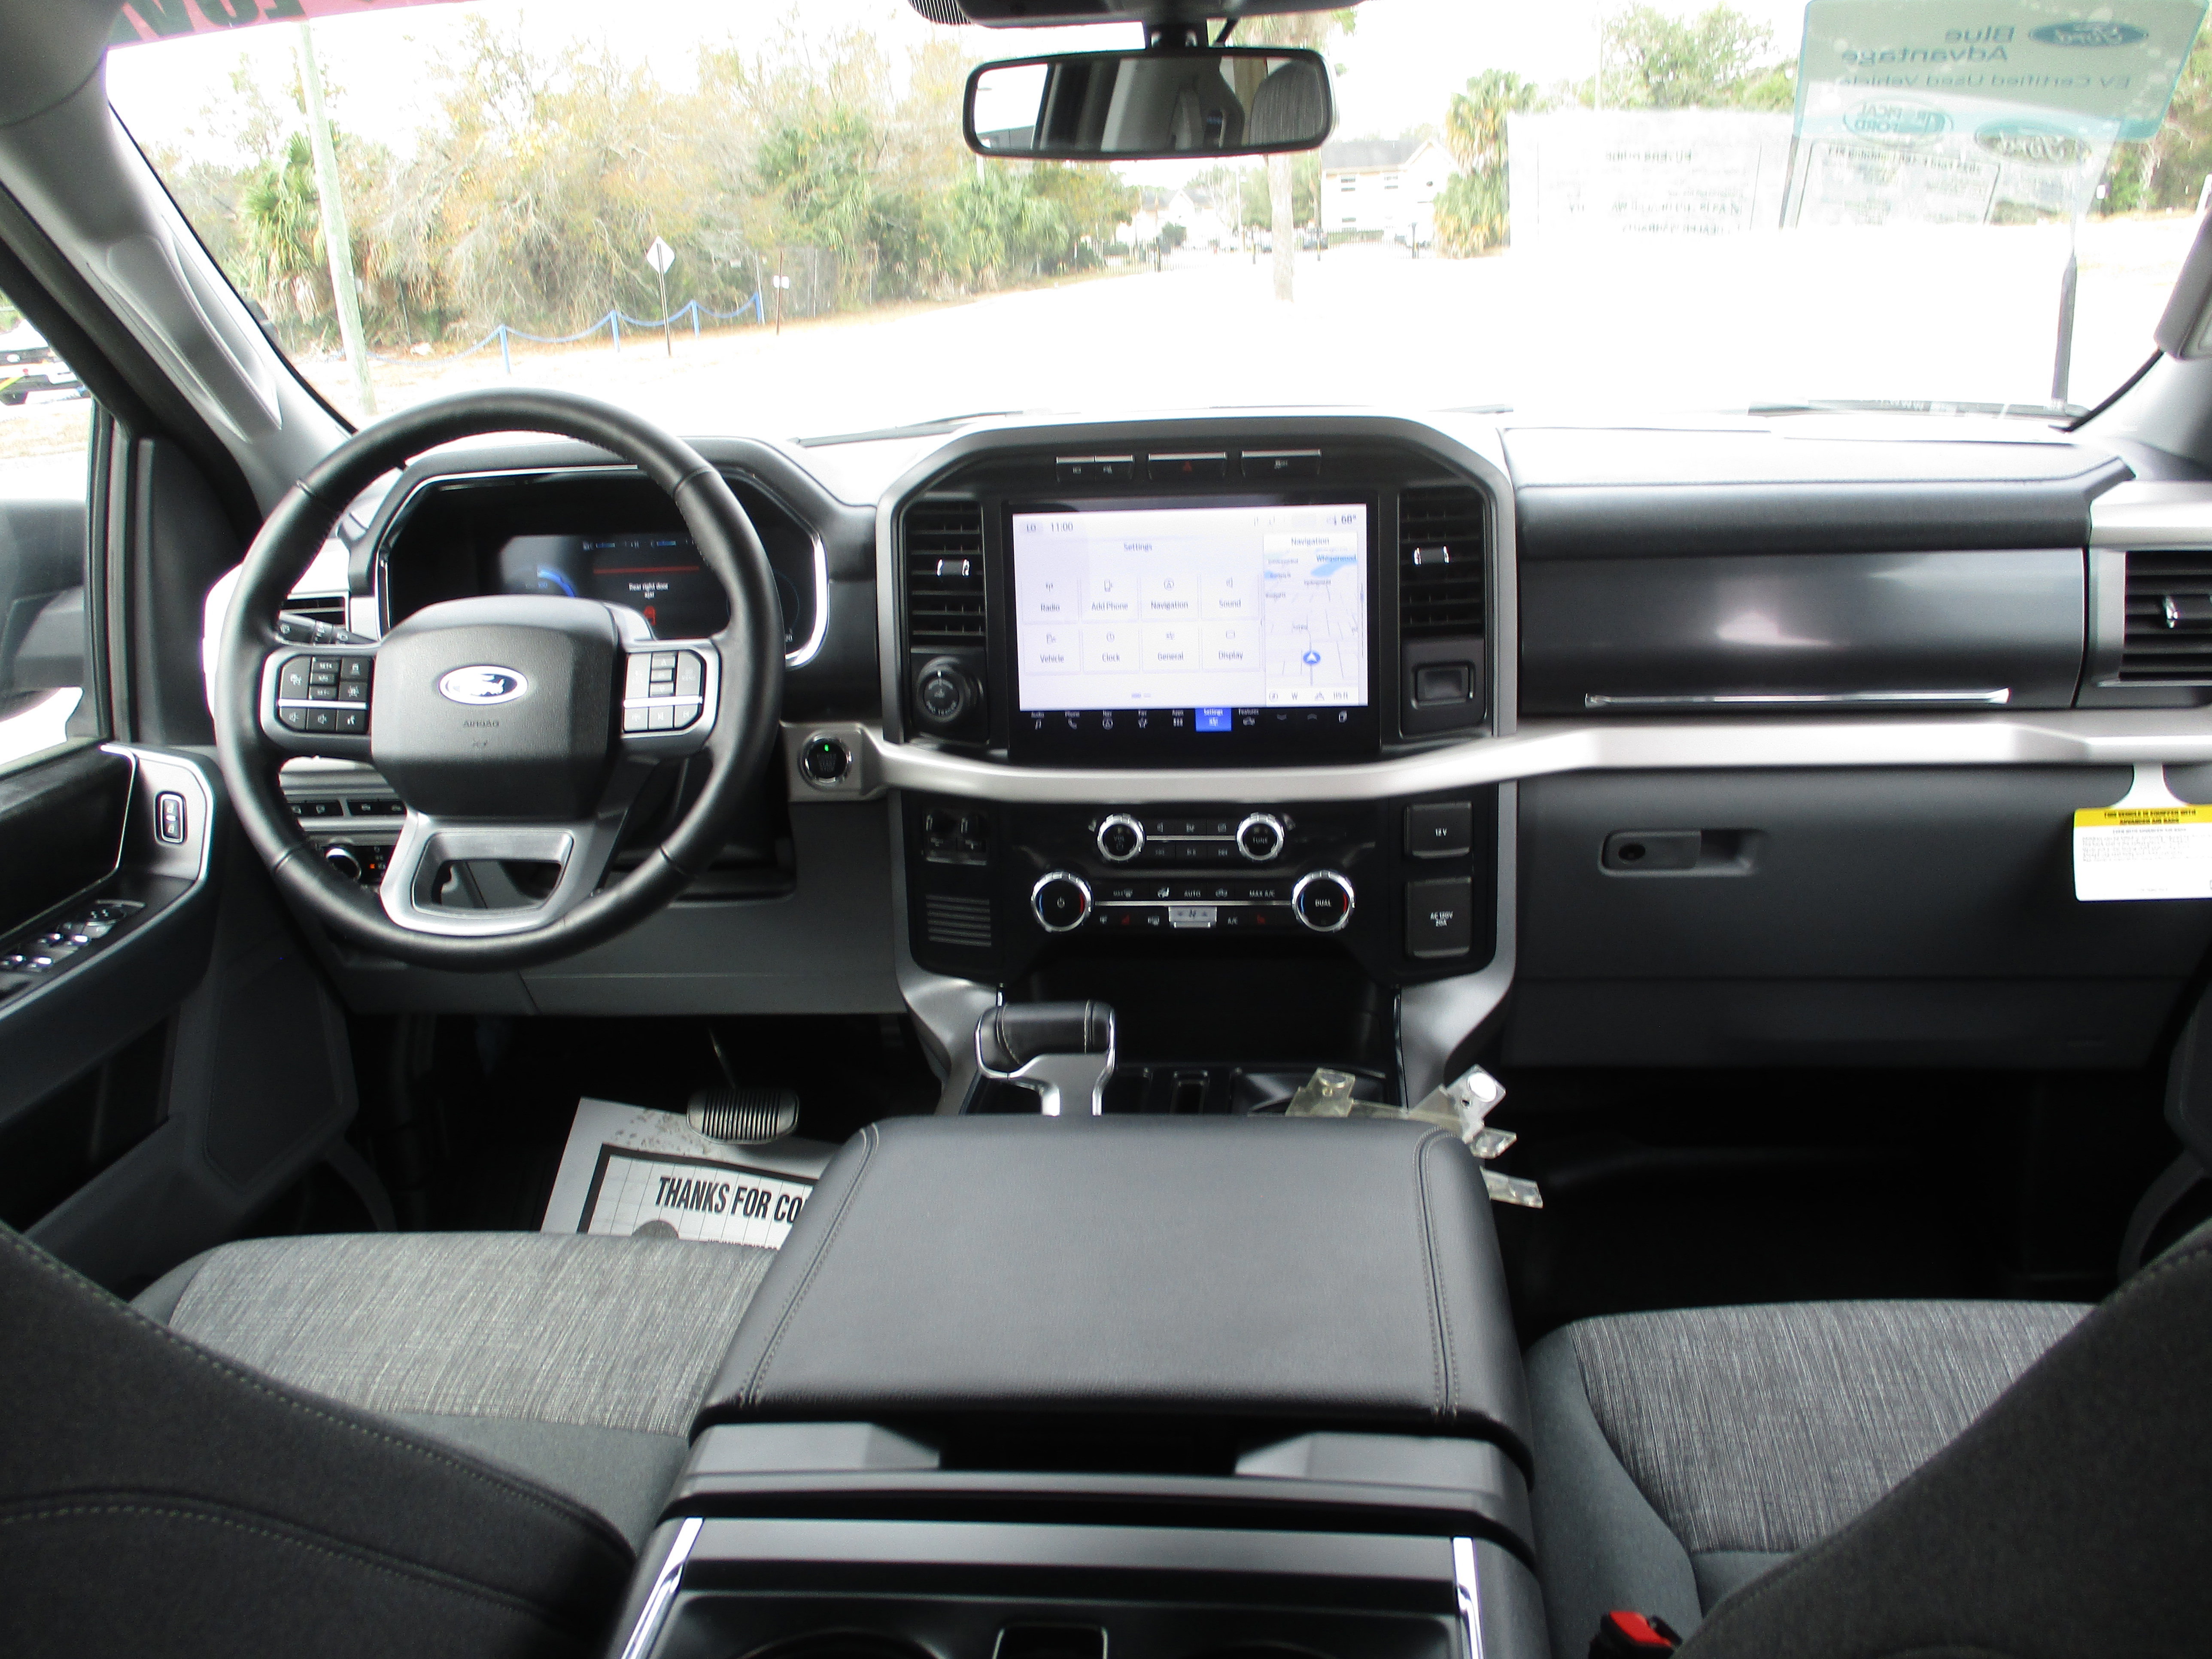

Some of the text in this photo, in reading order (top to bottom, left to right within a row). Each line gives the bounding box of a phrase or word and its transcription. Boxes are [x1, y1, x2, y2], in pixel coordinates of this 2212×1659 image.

[1051, 522, 1073, 532] 11:00
[1291, 537, 1329, 547] Navigation
[1124, 543, 1153, 553] Settings
[628, 582, 668, 592] Rear right door
[1041, 603, 1060, 612] Radio
[1091, 601, 1128, 611] Add Phone
[1151, 600, 1188, 610] Navigation
[1219, 599, 1241, 608] Sound
[1040, 654, 1064, 664] Vehicle
[1102, 653, 1120, 662] Clock
[1158, 651, 1184, 662] General
[1218, 650, 1243, 660] Display
[1292, 692, 1298, 700] W
[1203, 708, 1223, 716] Settings
[1239, 708, 1259, 716] Features
[1315, 899, 1332, 907] DUAL
[655, 1176, 807, 1223] THANKS FOR CO
